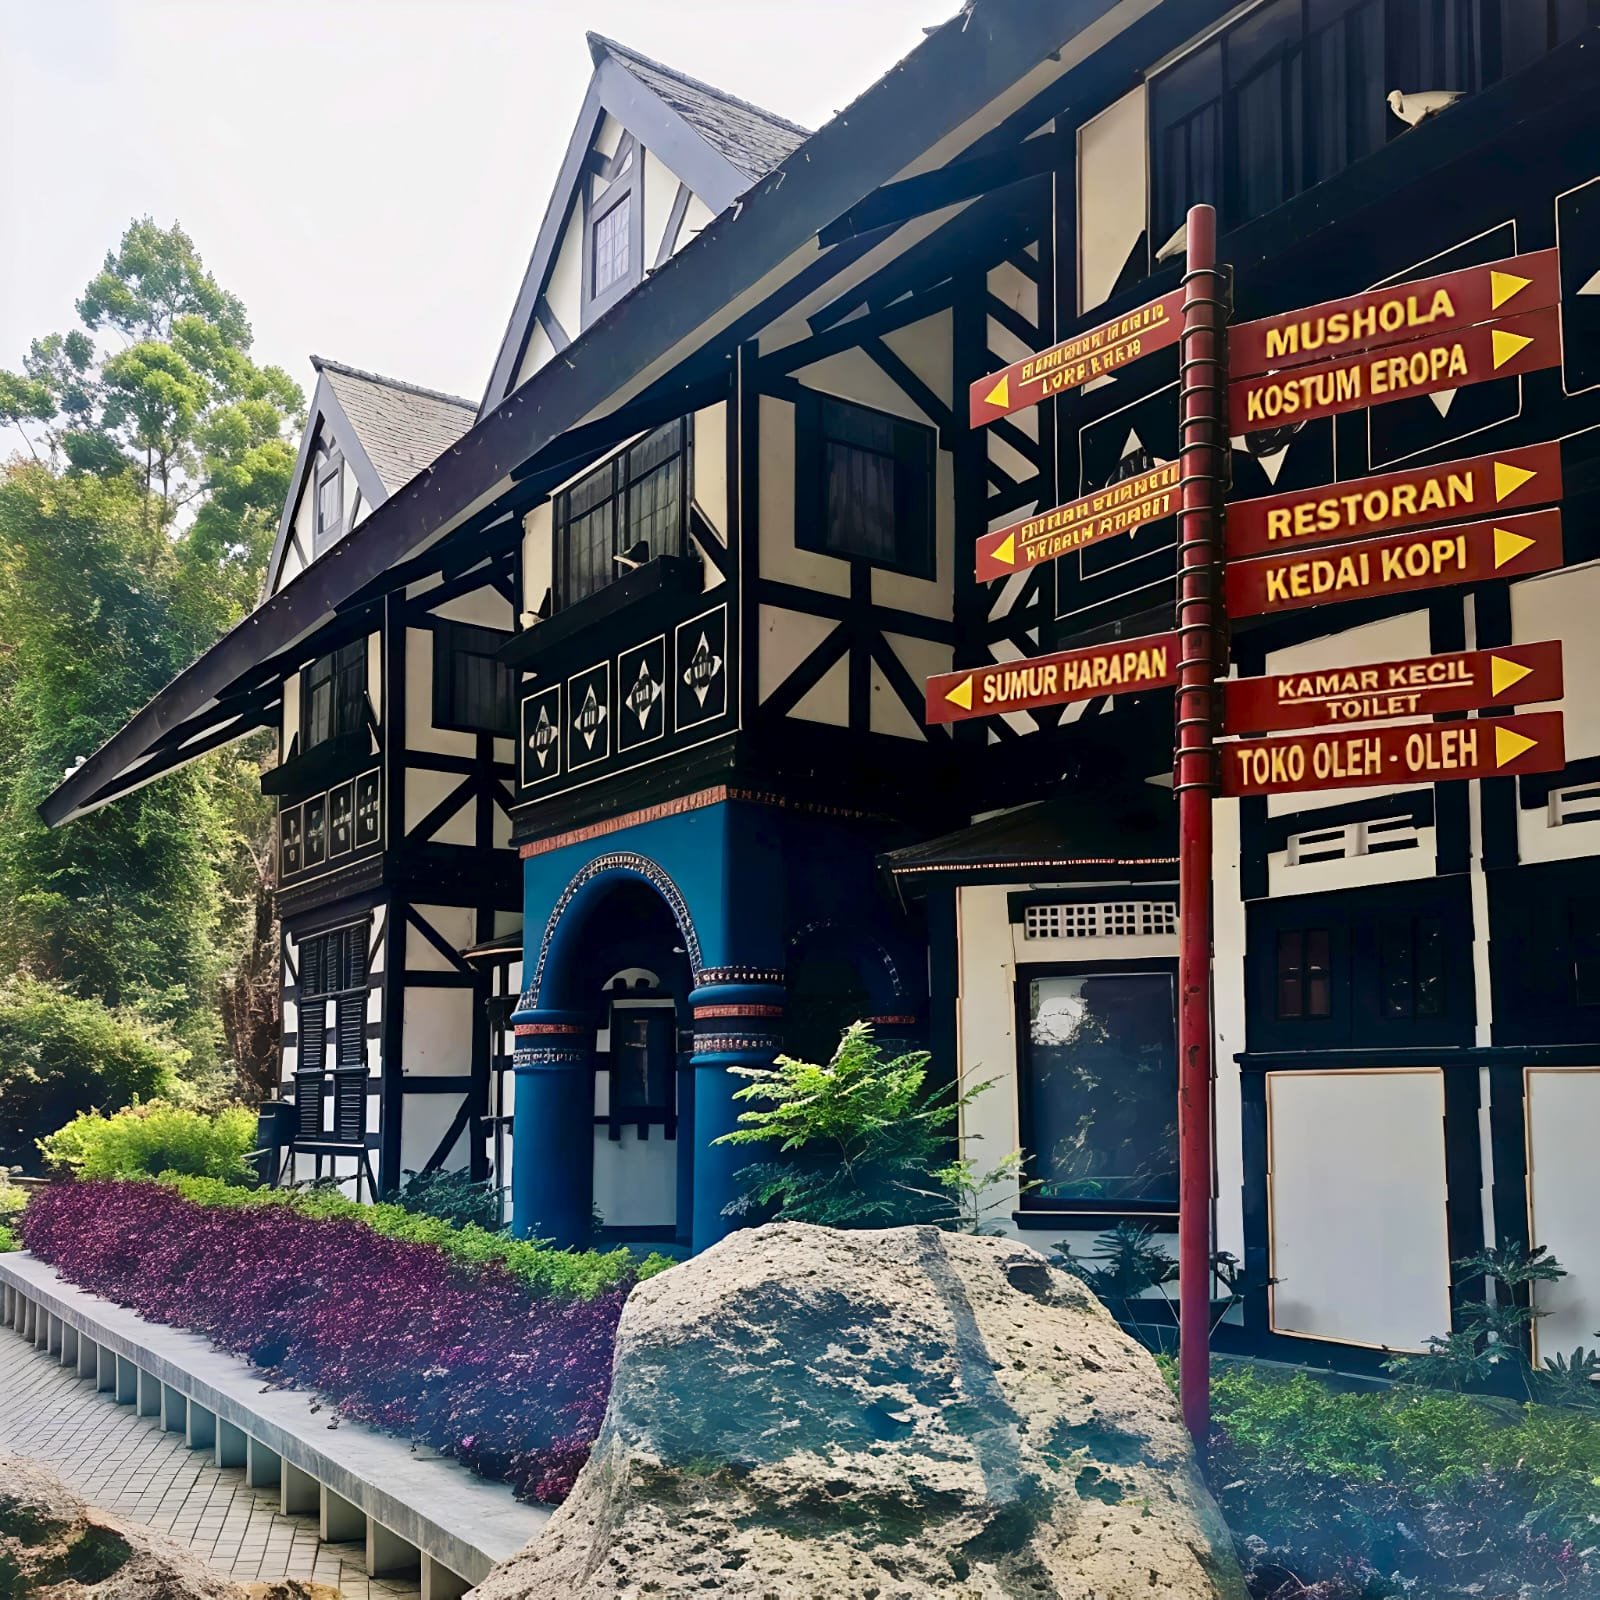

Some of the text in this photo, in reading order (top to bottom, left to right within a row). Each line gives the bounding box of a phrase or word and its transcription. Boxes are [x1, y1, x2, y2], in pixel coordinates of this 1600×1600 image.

[1265, 289, 1455, 358] MUSHOLA
[1247, 344, 1468, 421] KOSTUM EROPA
[1267, 472, 1474, 540] RESTORAN
[1266, 535, 1466, 602] KEDAI KOPI
[983, 647, 1167, 703] SUMUR HARAPAN
[1278, 660, 1474, 698] KAMAR KECIL
[1327, 694, 1421, 719] TOILET
[1237, 745, 1305, 785] TOKO
[1313, 737, 1382, 779] OLEH
[1406, 728, 1478, 772] OLEH
